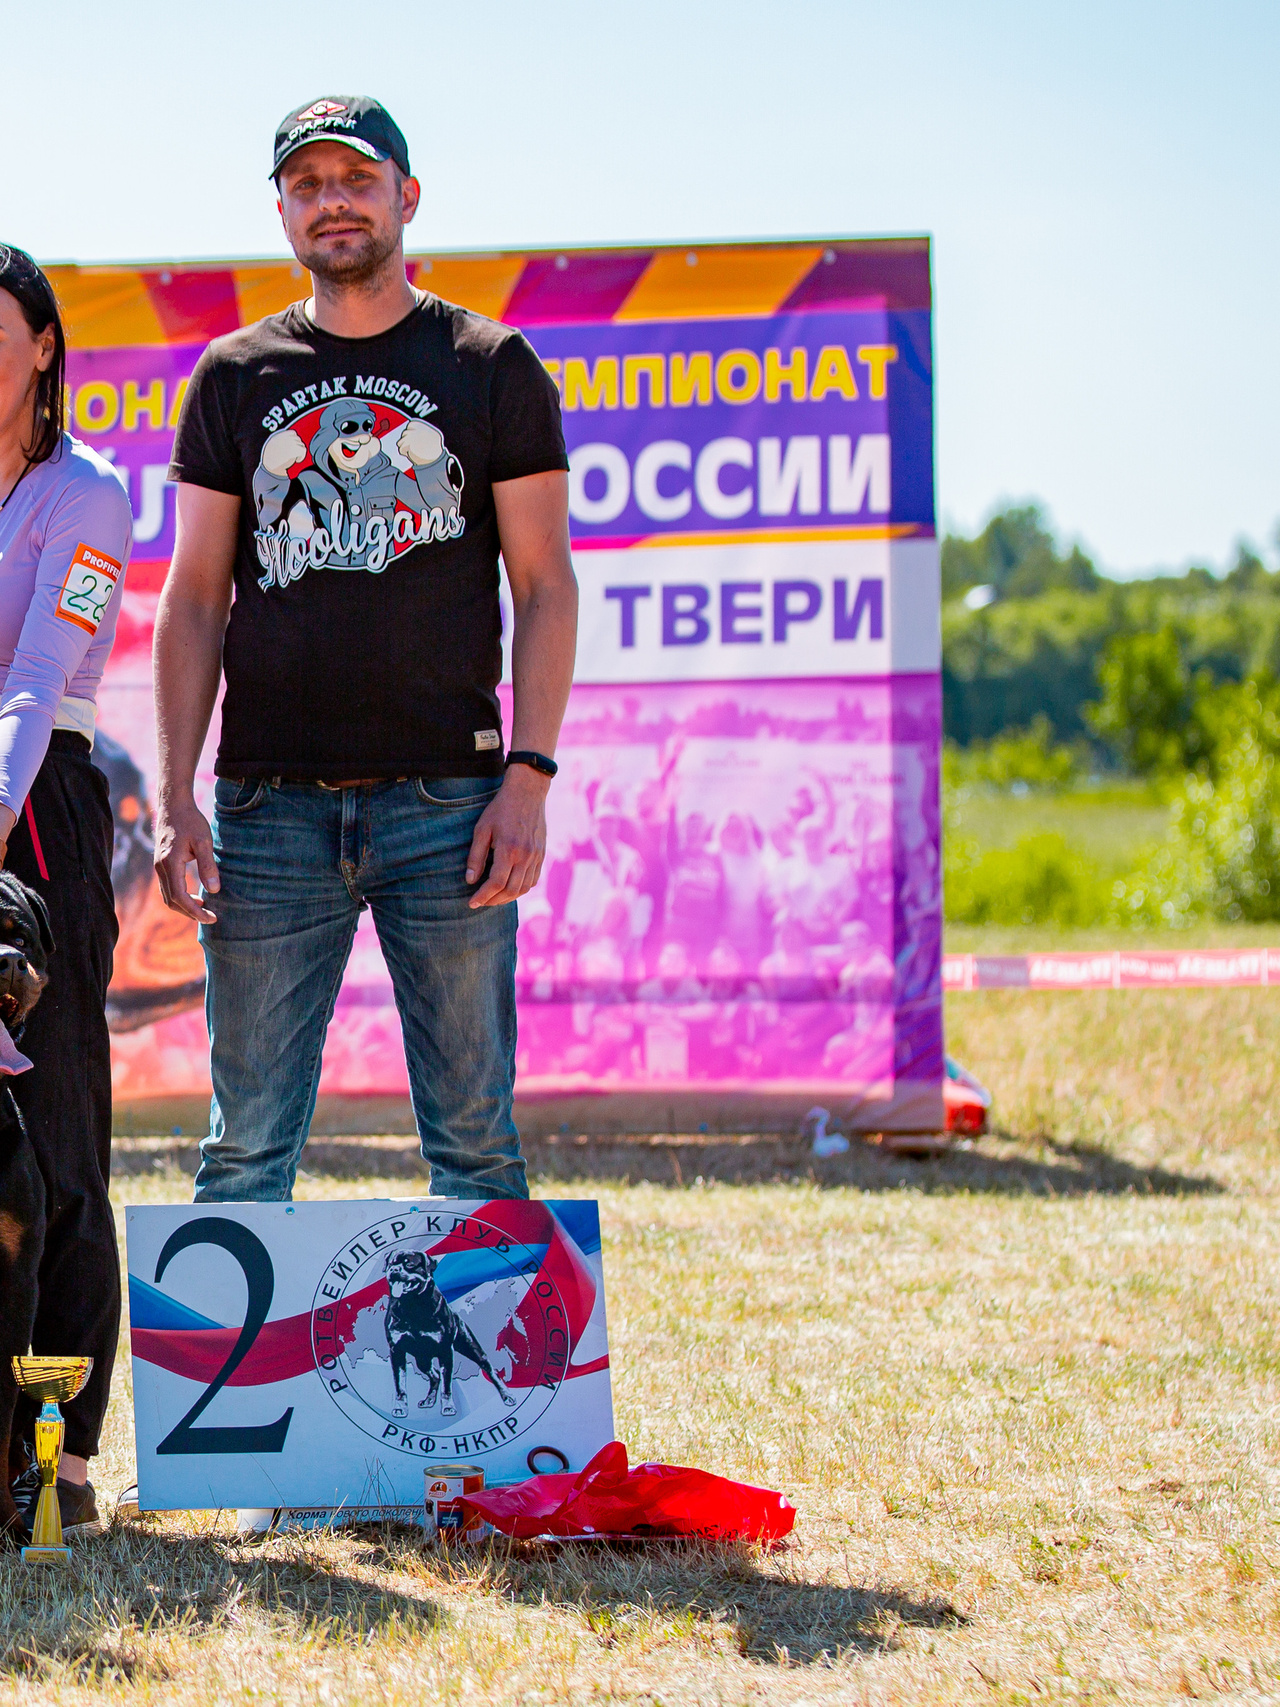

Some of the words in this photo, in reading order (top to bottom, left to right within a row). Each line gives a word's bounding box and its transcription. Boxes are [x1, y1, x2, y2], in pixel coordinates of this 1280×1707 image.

[288, 115, 358, 142] СПАРТАК
[261, 376, 347, 432] SPARTAK
[353, 375, 439, 418] MOSCOW
[254, 499, 465, 593] Hooligans
[604, 577, 885, 649] ТВЕРИ
[154, 1216, 294, 1455] 2
[316, 1220, 407, 1394] РОТВЕЙЛЕР
[426, 1215, 514, 1254] КЛУБ
[521, 1260, 567, 1392] РОССИИ
[381, 1416, 520, 1455] РКФ-НКПР
[287, 1509, 327, 1521] Корма
